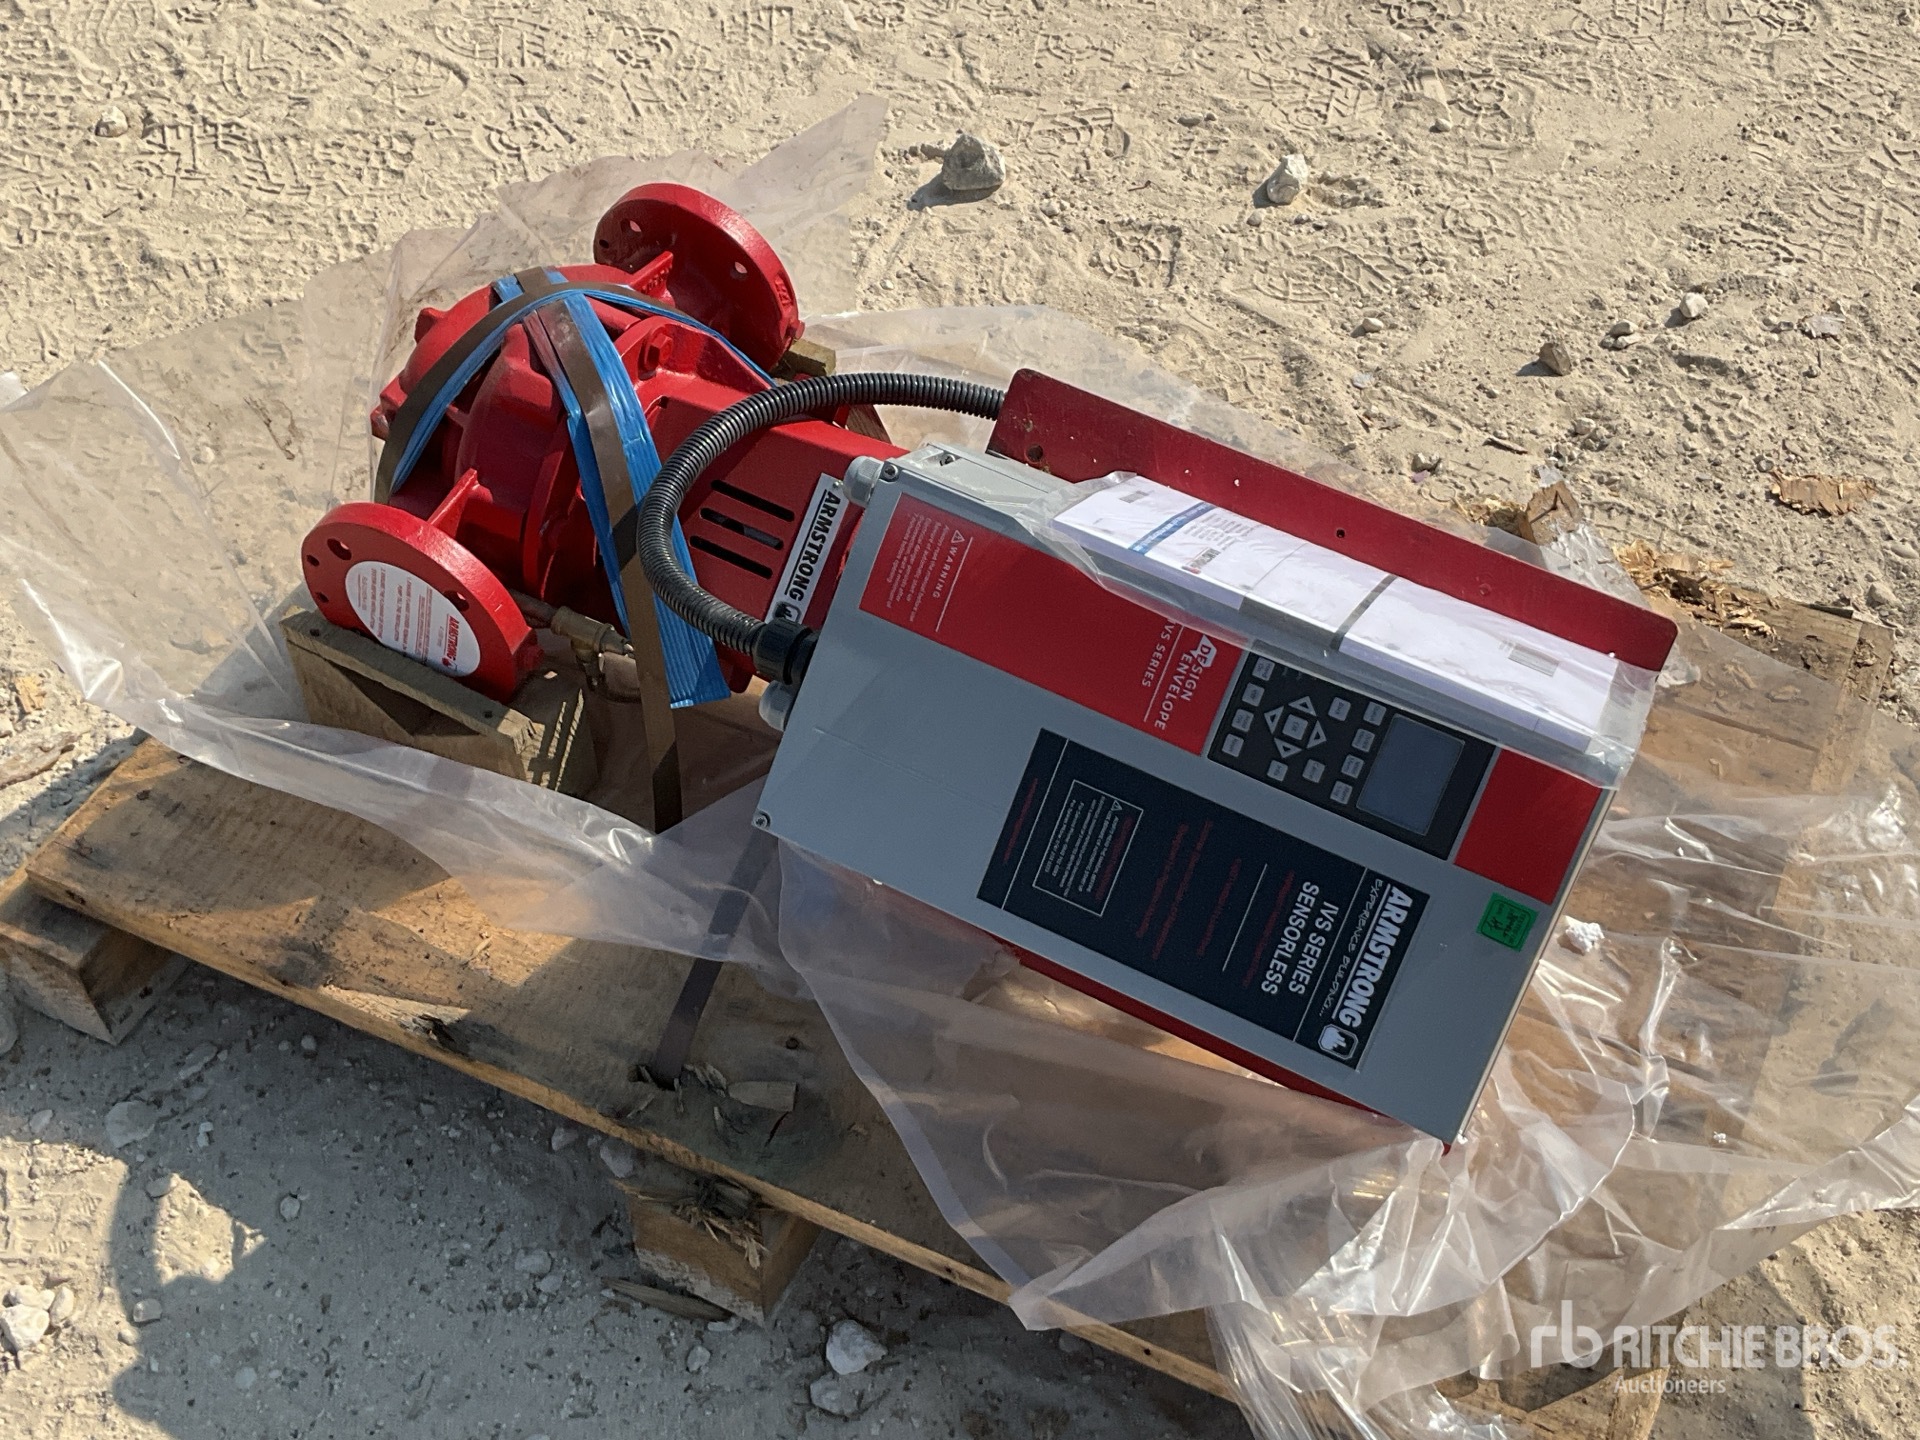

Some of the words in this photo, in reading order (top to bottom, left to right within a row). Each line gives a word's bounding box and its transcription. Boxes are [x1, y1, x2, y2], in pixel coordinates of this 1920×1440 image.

[789, 491, 840, 601] ARMSTRONG
[931, 545, 958, 599] WARNING
[1141, 642, 1165, 688] SERIES
[1153, 651, 1192, 730] ENVELOPE
[1180, 642, 1211, 701] DESIGN
[1259, 879, 1320, 996] SENSORLESS
[1313, 900, 1339, 932] IVS
[1344, 877, 1384, 954] EXPERIENCE
[1286, 930, 1326, 996] SERIES
[1336, 885, 1415, 1030] ARMSTRONG
